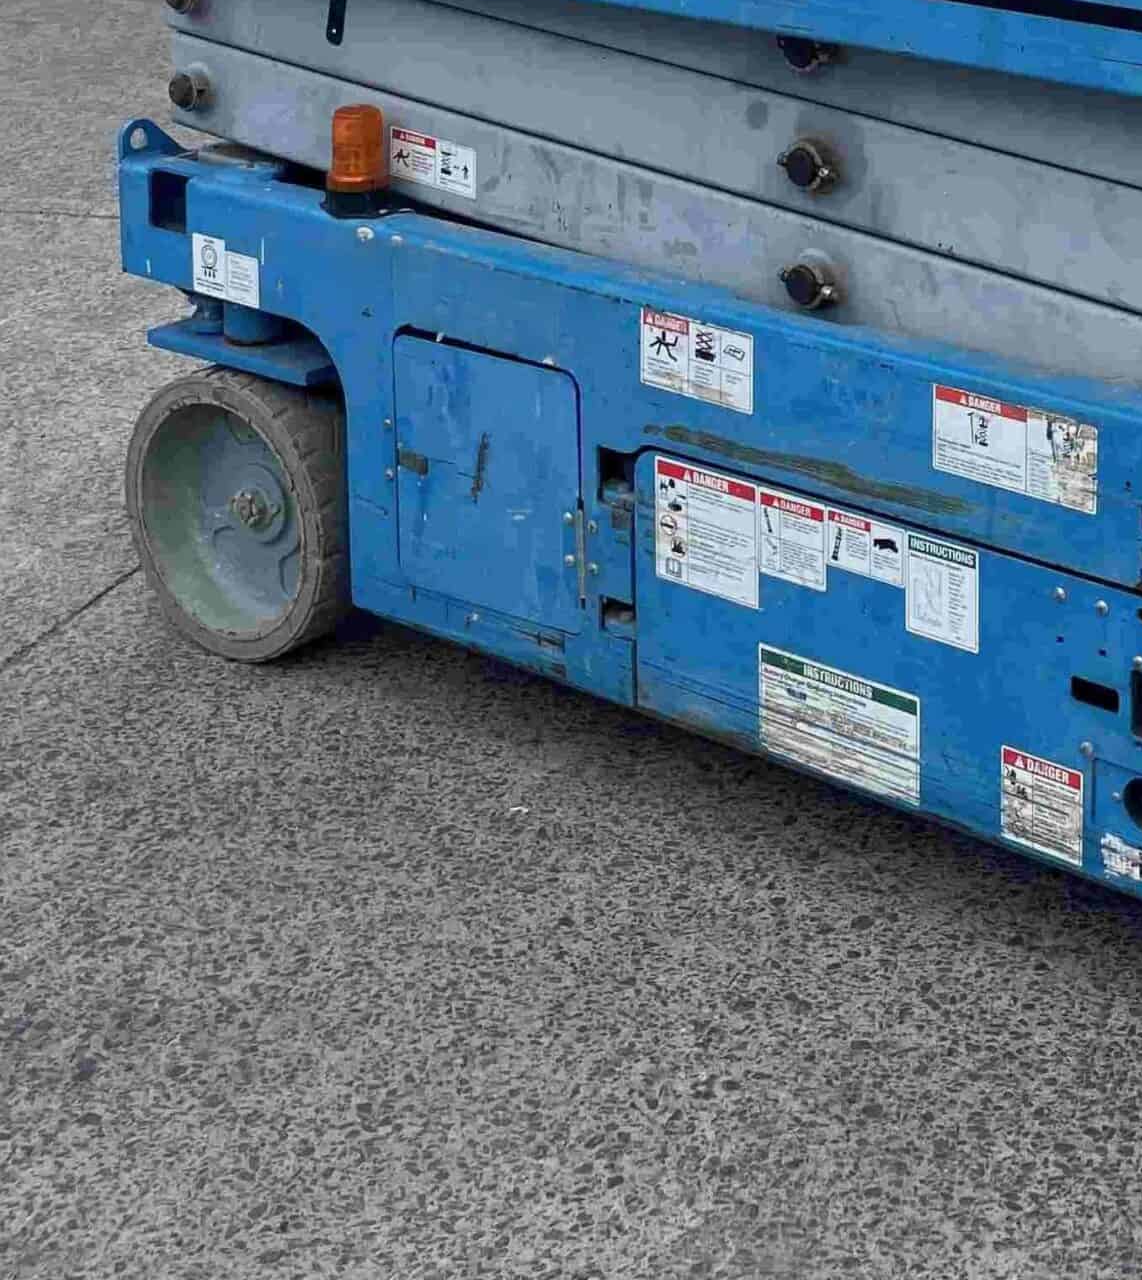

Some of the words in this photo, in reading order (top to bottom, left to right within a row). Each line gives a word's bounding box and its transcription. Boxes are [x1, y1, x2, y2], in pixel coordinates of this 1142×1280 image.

[968, 395, 1002, 413] DANGER
[693, 471, 729, 493] DANGER
[779, 499, 811, 518] DANGER
[910, 535, 975, 565] INSTRUCTIONS
[803, 663, 873, 698] INSTRUCTIONS
[1026, 758, 1070, 785] DANGER
